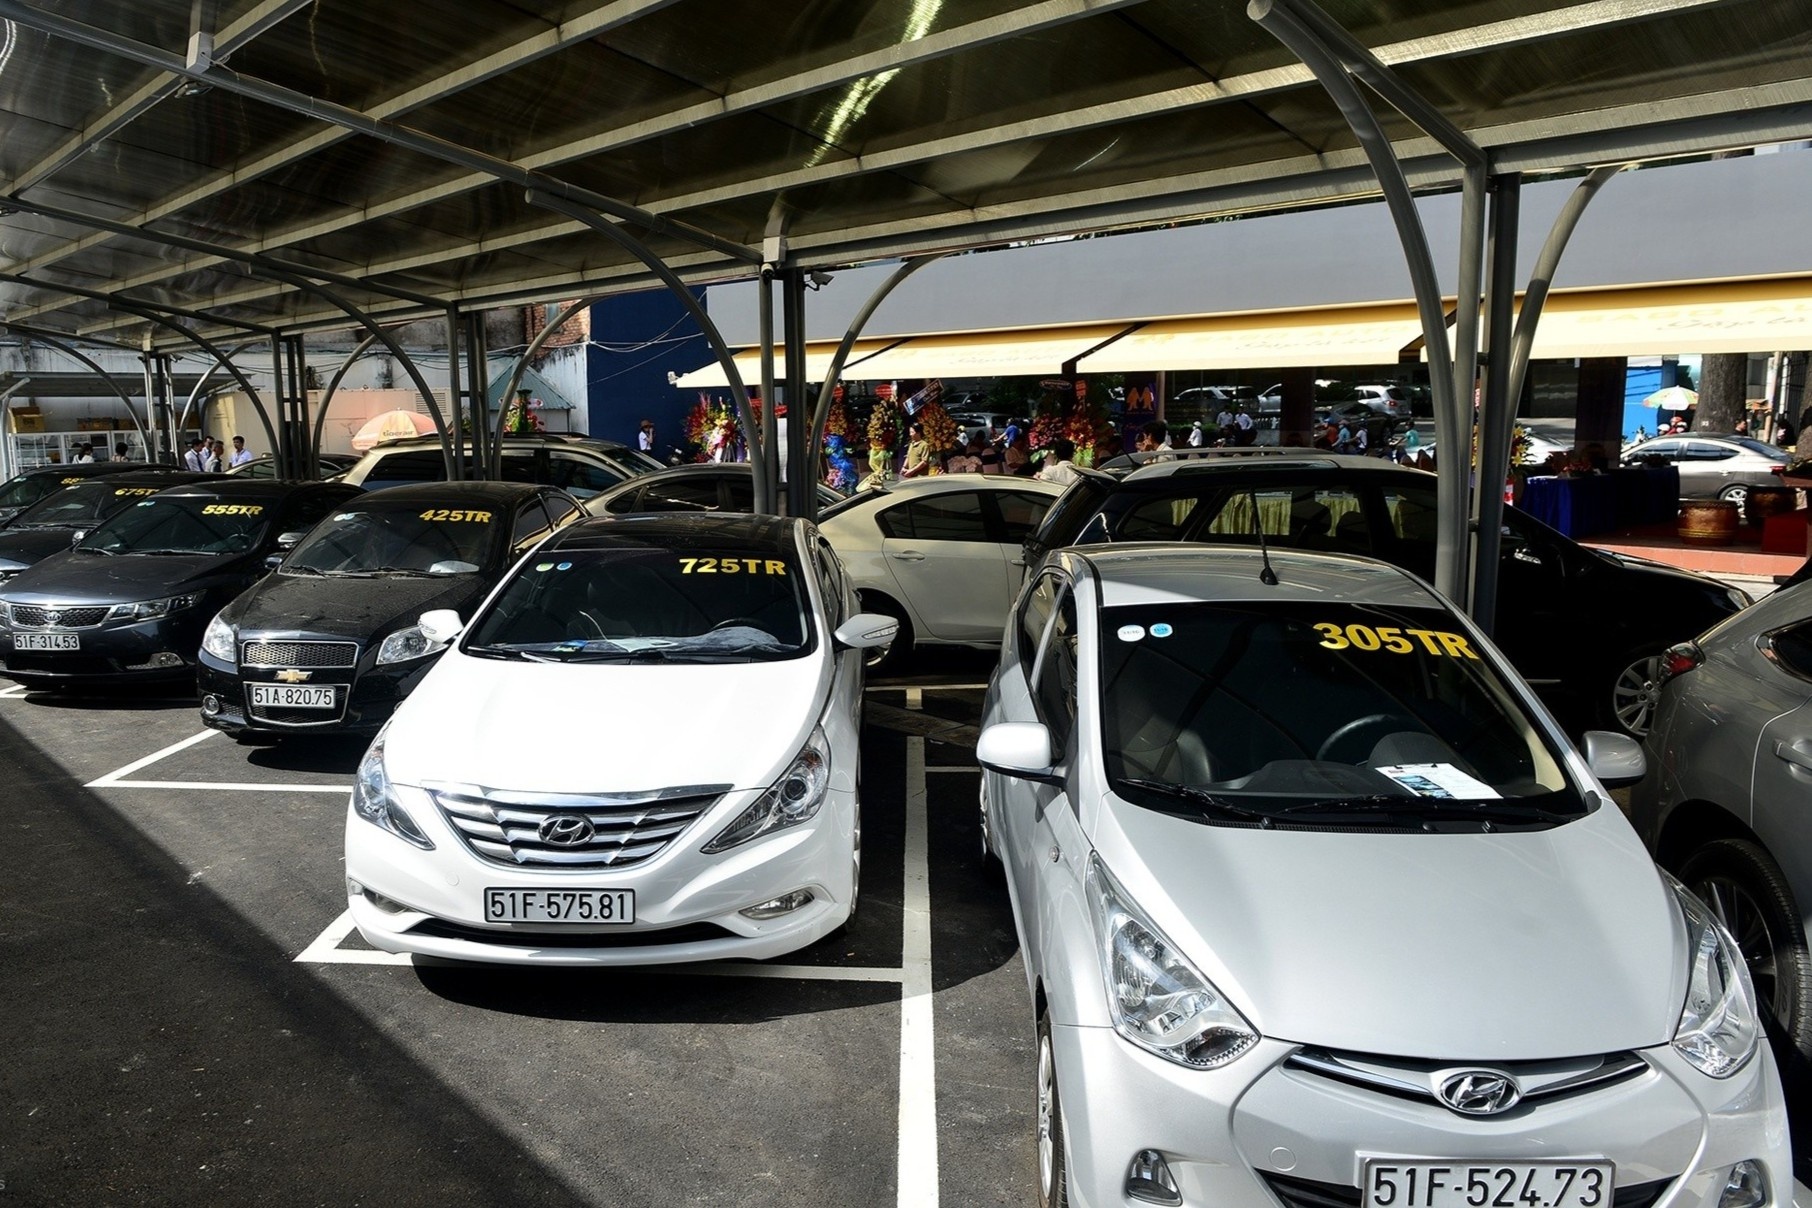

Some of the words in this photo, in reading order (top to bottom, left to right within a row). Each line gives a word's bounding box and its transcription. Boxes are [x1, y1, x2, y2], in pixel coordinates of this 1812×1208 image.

[201, 504, 264, 515] 555TR
[418, 509, 492, 523] 425TR
[679, 558, 786, 576] 725TR
[15, 635, 79, 649] 51F-314.53
[1312, 622, 1480, 660] 305TR
[254, 687, 333, 706] 51A-820.75
[490, 891, 626, 920] 51F-575.81
[1373, 1166, 1605, 1208] 51F-524.73
